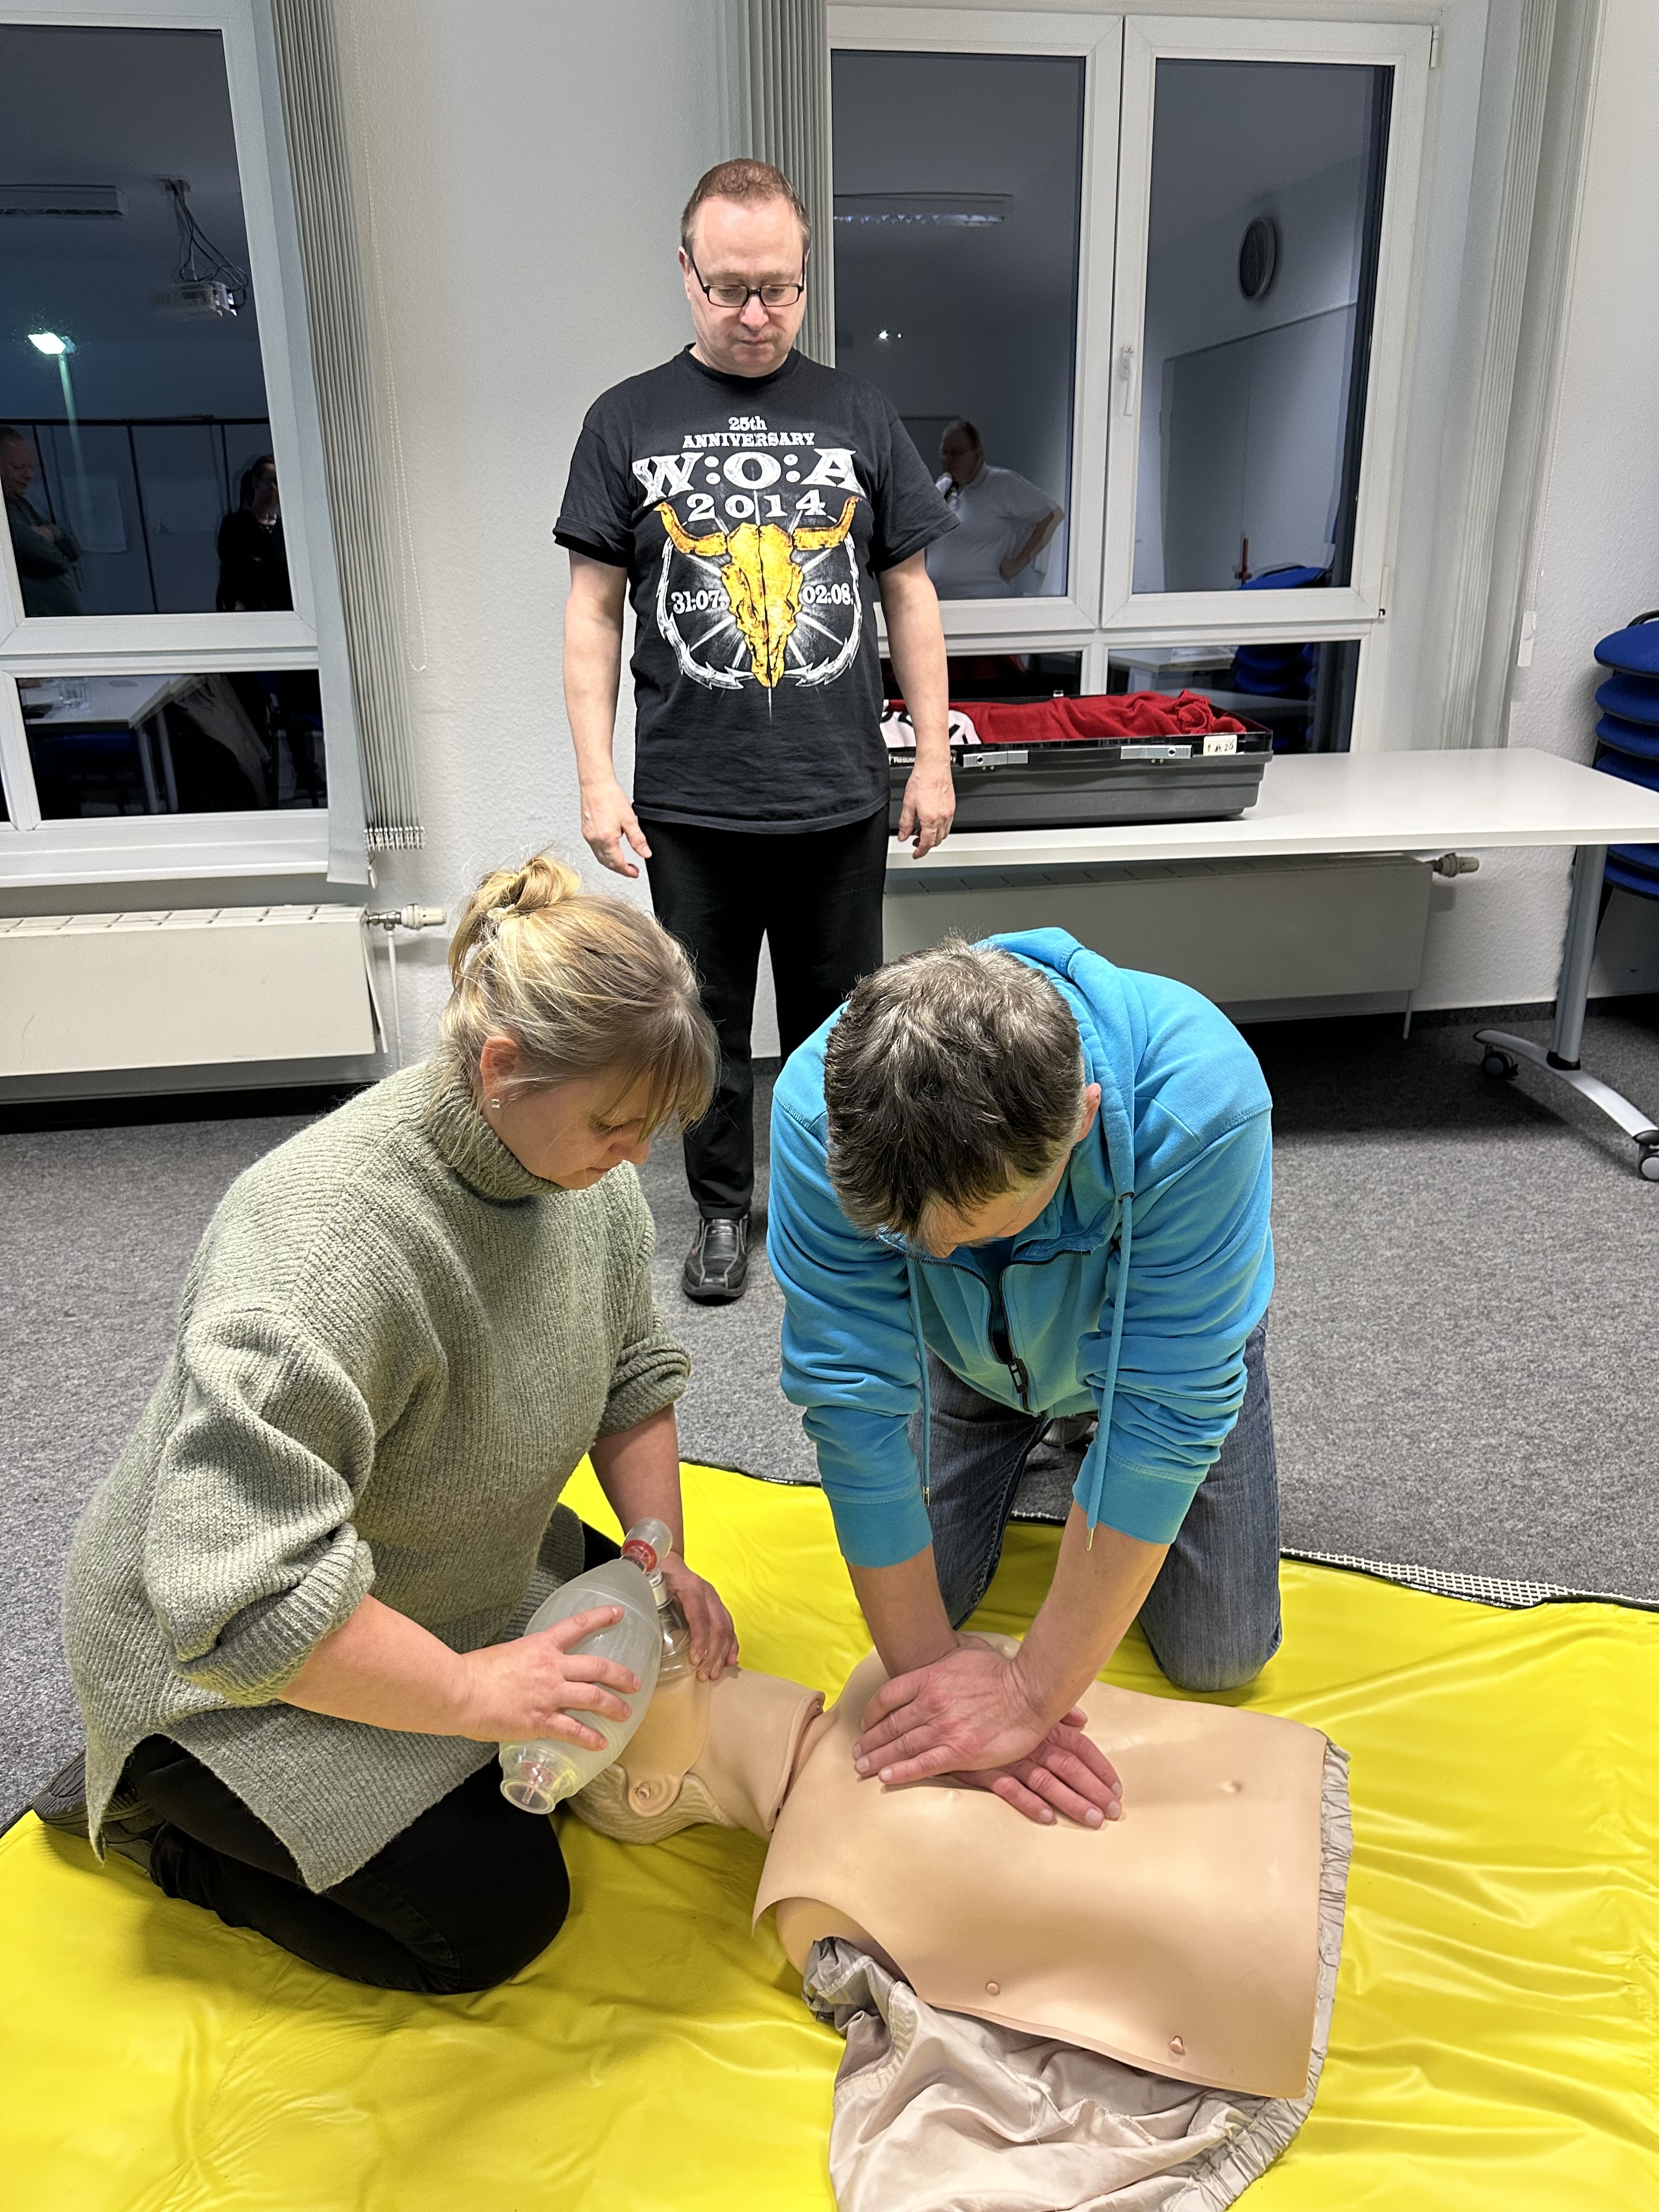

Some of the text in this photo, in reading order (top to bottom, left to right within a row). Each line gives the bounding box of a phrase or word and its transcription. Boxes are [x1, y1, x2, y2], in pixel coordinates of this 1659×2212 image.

[729, 415, 768, 431] 25th
[682, 432, 815, 449] ANNIVERSARY
[686, 489, 827, 522] 2014
